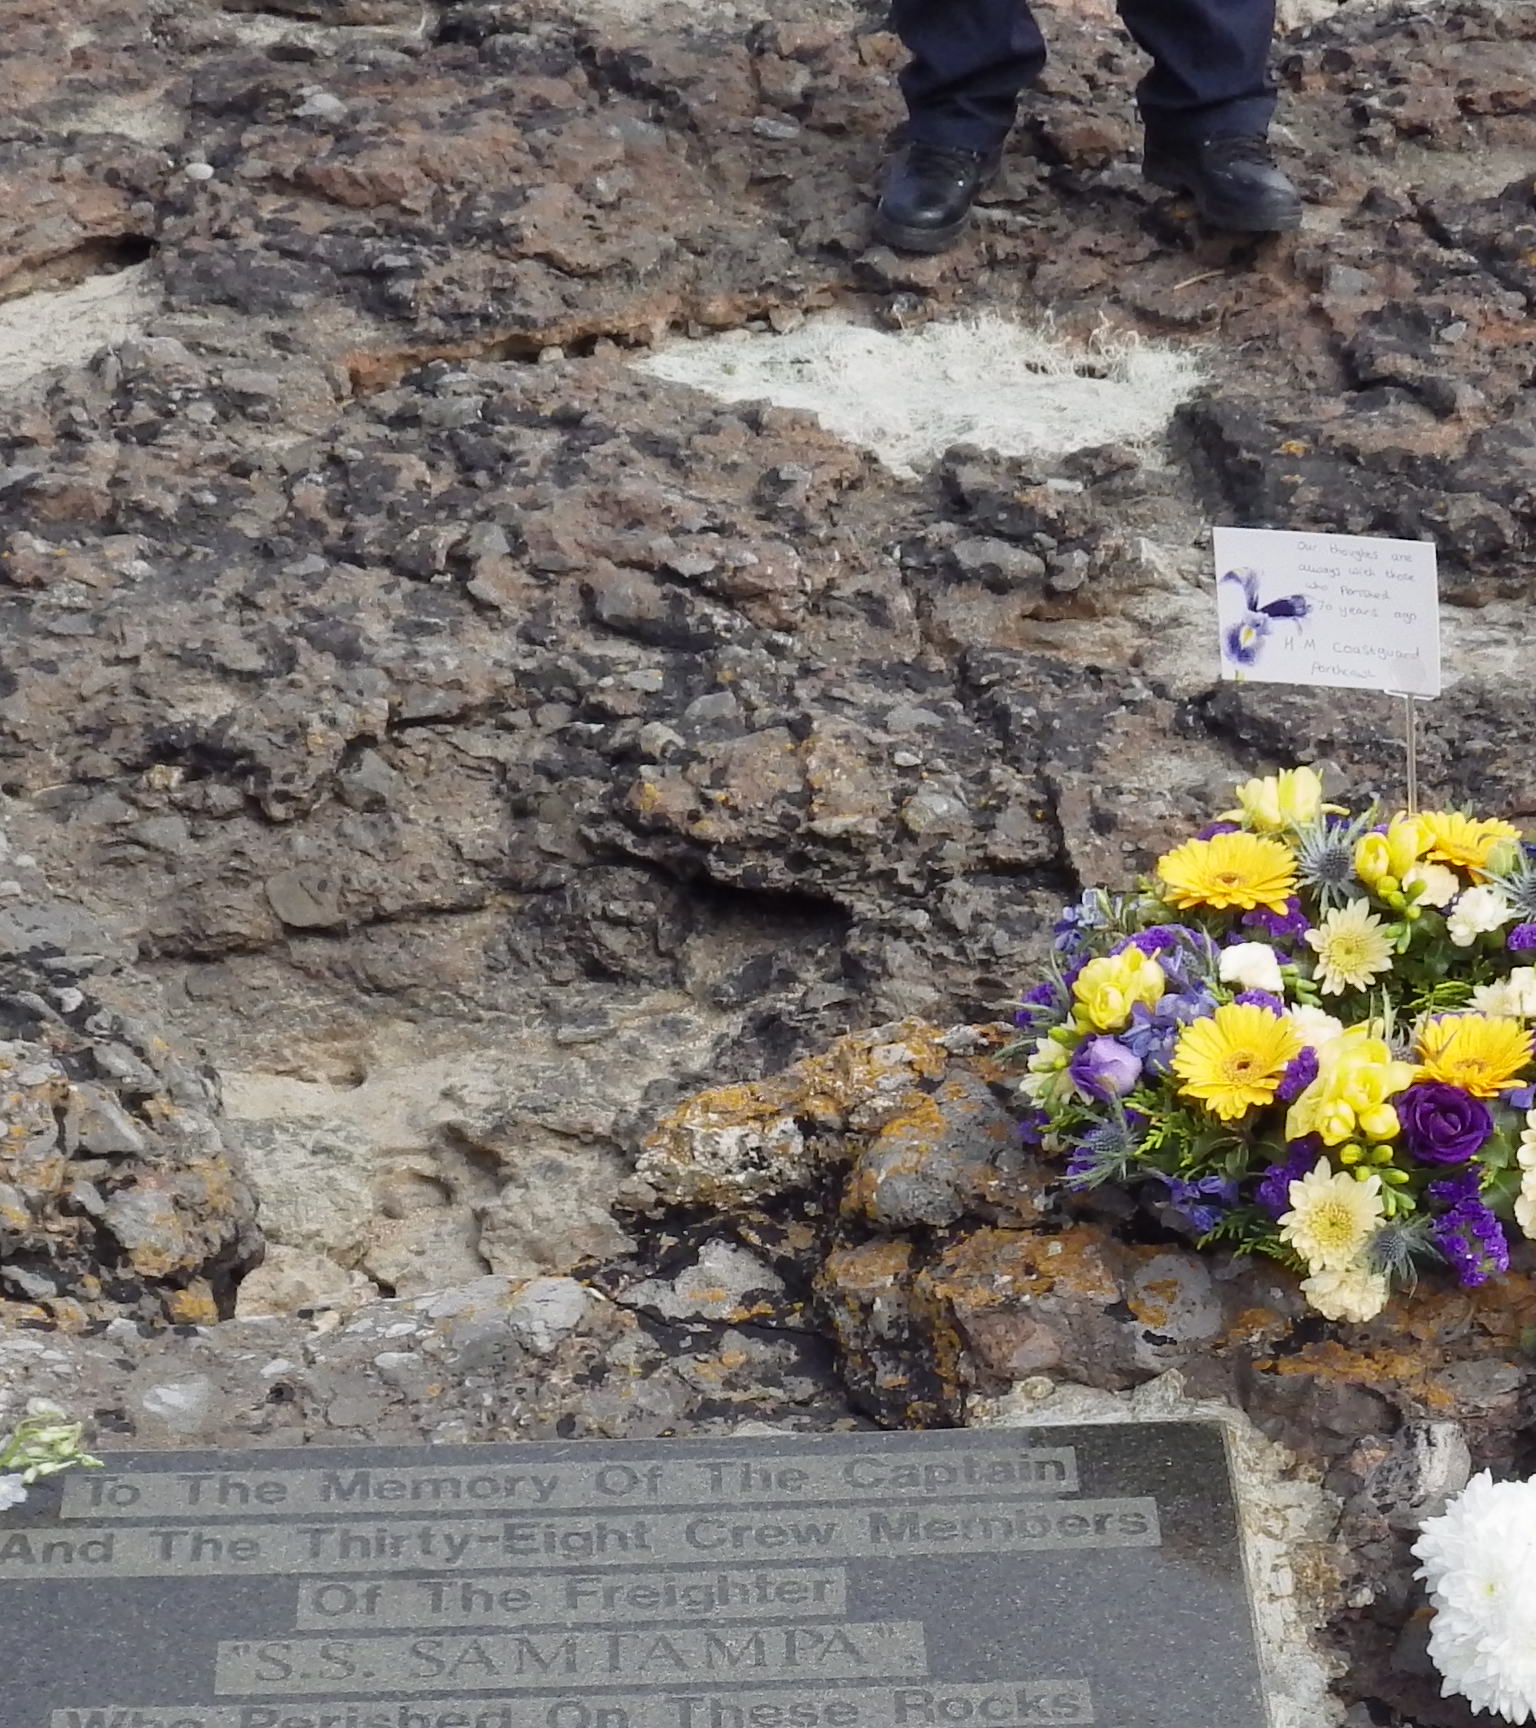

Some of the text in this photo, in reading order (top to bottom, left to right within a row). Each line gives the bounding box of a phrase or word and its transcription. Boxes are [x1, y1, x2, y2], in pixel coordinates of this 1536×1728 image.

[1348, 567, 1376, 577] with
[1339, 605, 1378, 617] years
[86, 1454, 1066, 1507] To The Memory Of The Captain
[151, 1529, 260, 1562] The
[295, 1519, 654, 1564] Thirty-Eight
[686, 1517, 837, 1550] Crew
[869, 1507, 1149, 1545] Members
[312, 1574, 835, 1616] Of The Freighter
[232, 1640, 374, 1682] "S.S.
[893, 1686, 1081, 1724] Rocks
